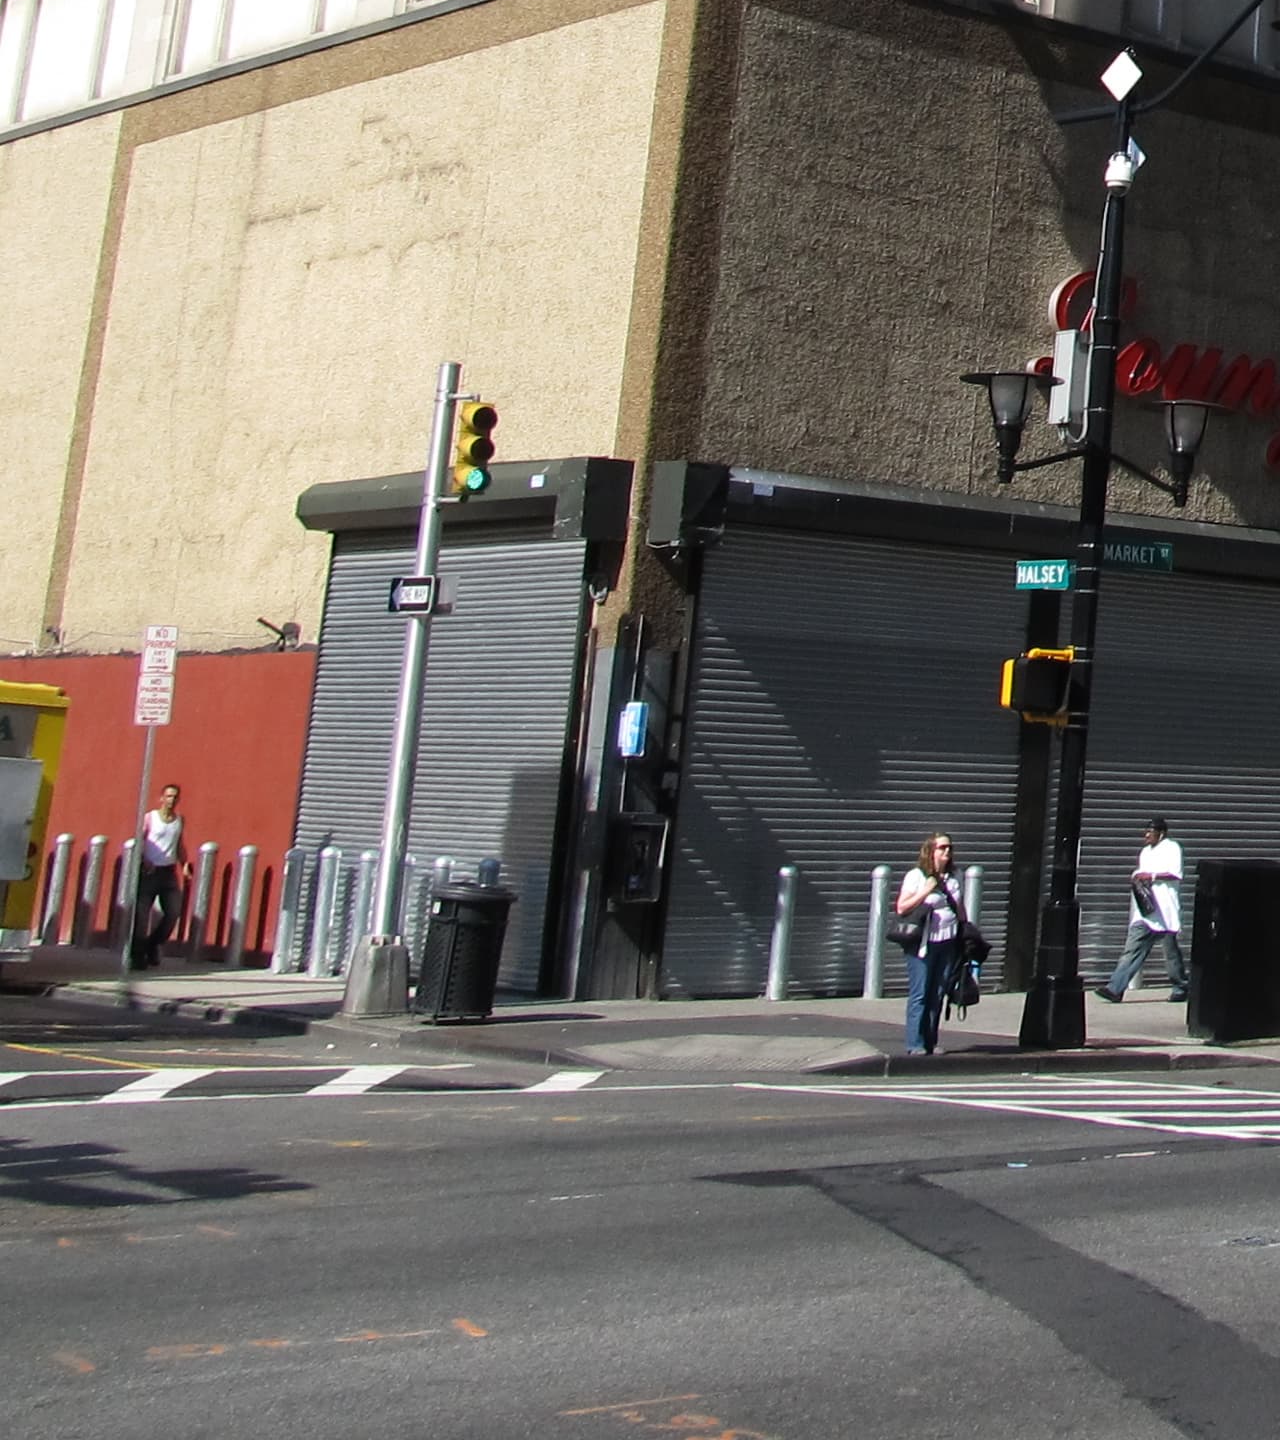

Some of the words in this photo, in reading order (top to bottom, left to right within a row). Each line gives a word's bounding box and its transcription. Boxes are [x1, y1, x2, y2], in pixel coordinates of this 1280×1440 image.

[1103, 543, 1155, 563] MARKET
[1160, 547, 1169, 558] ST
[1017, 563, 1066, 585] HALSEY
